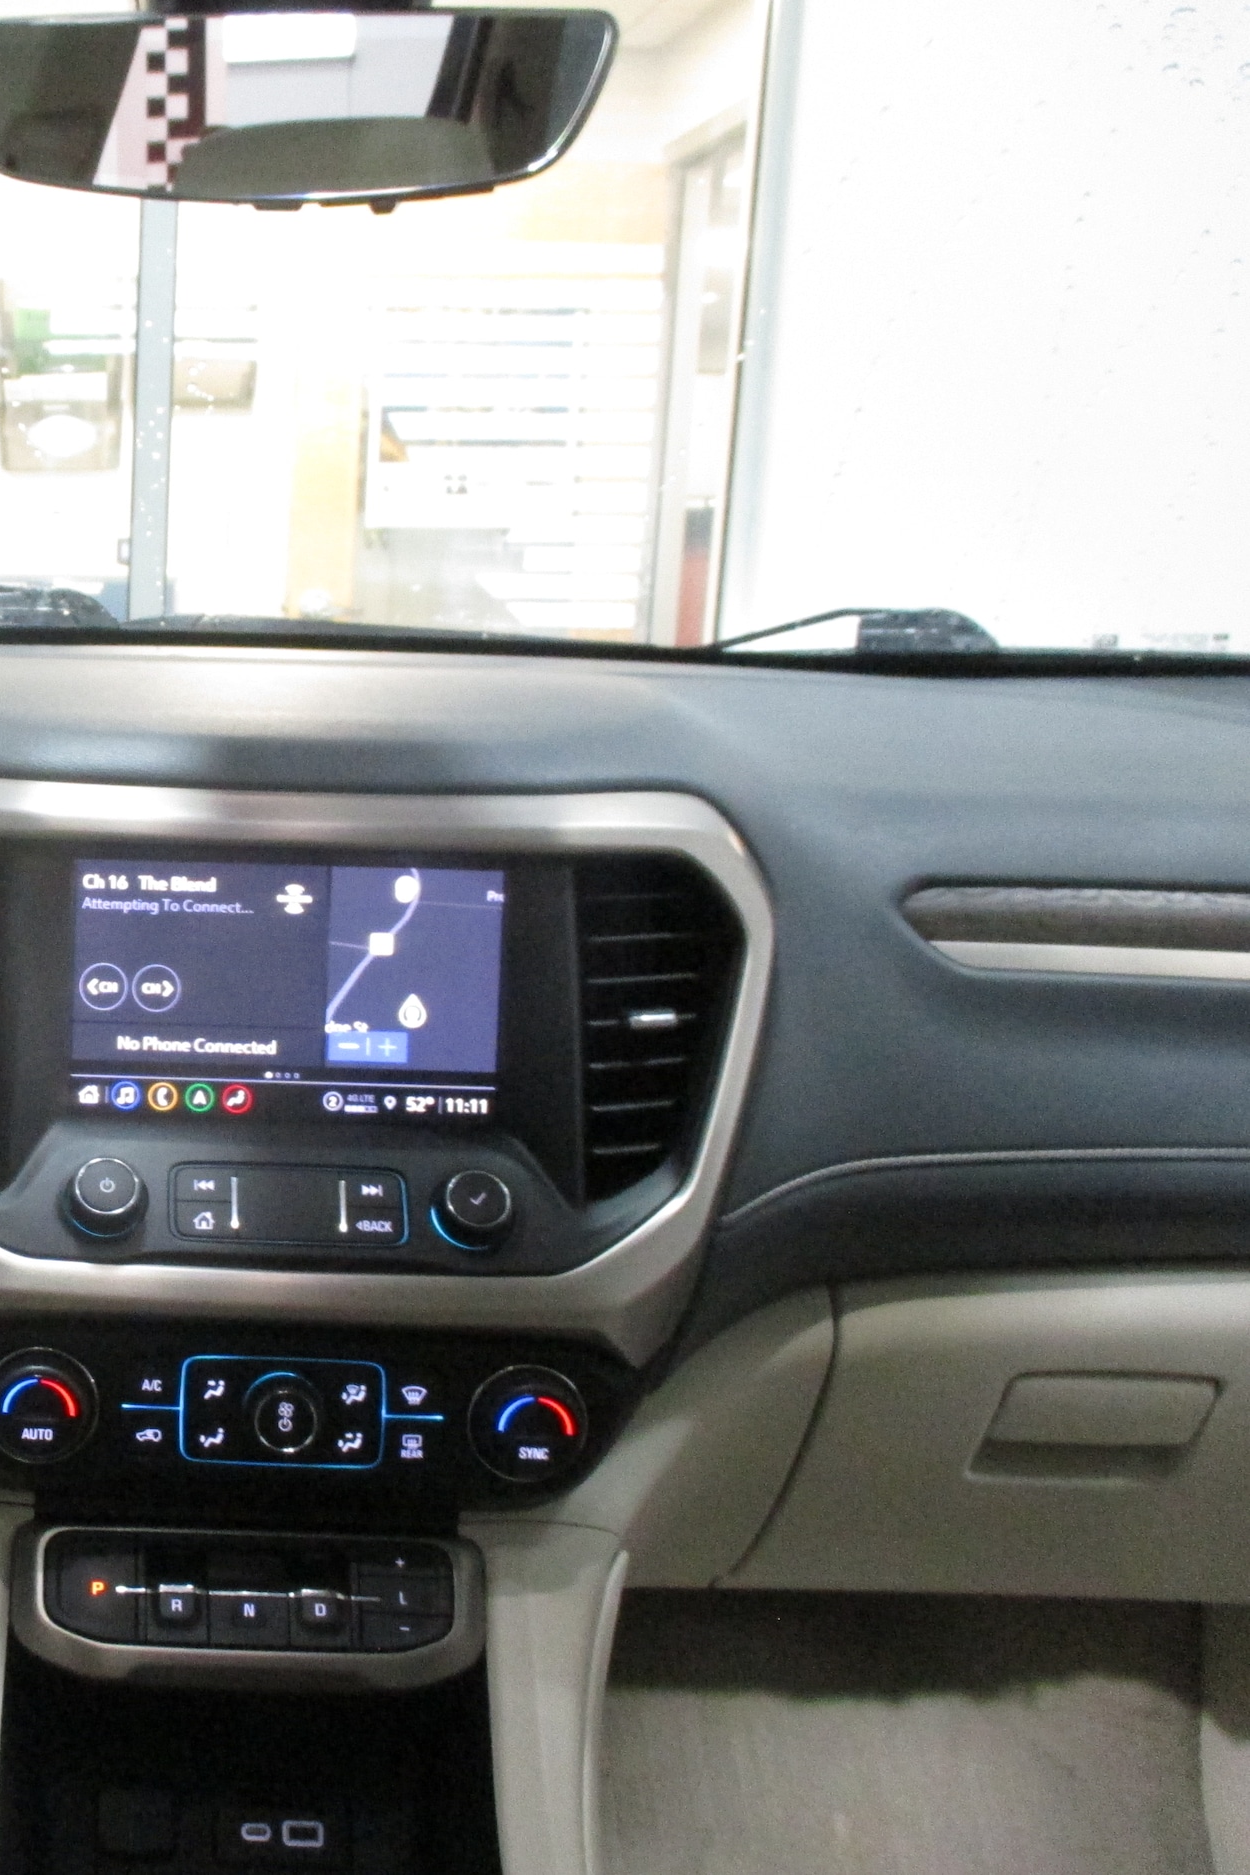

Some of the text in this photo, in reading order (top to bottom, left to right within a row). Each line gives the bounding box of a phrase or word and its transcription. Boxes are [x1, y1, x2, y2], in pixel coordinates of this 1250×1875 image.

[82, 873, 217, 893] Ch 16 The Blend
[82, 896, 255, 915] Attempting To Connect...
[116, 1035, 277, 1056] No Phone Connected
[445, 1097, 489, 1114] 11:11
[362, 1219, 394, 1232] BACK
[141, 1379, 163, 1392] A/C
[21, 1428, 54, 1441] AUTO
[400, 1449, 424, 1459] REAR
[518, 1446, 550, 1461] SYNC
[91, 1581, 106, 1596] P
[399, 1590, 408, 1605] L
[171, 1598, 183, 1613] R
[243, 1603, 256, 1618] N
[315, 1603, 327, 1617] D
